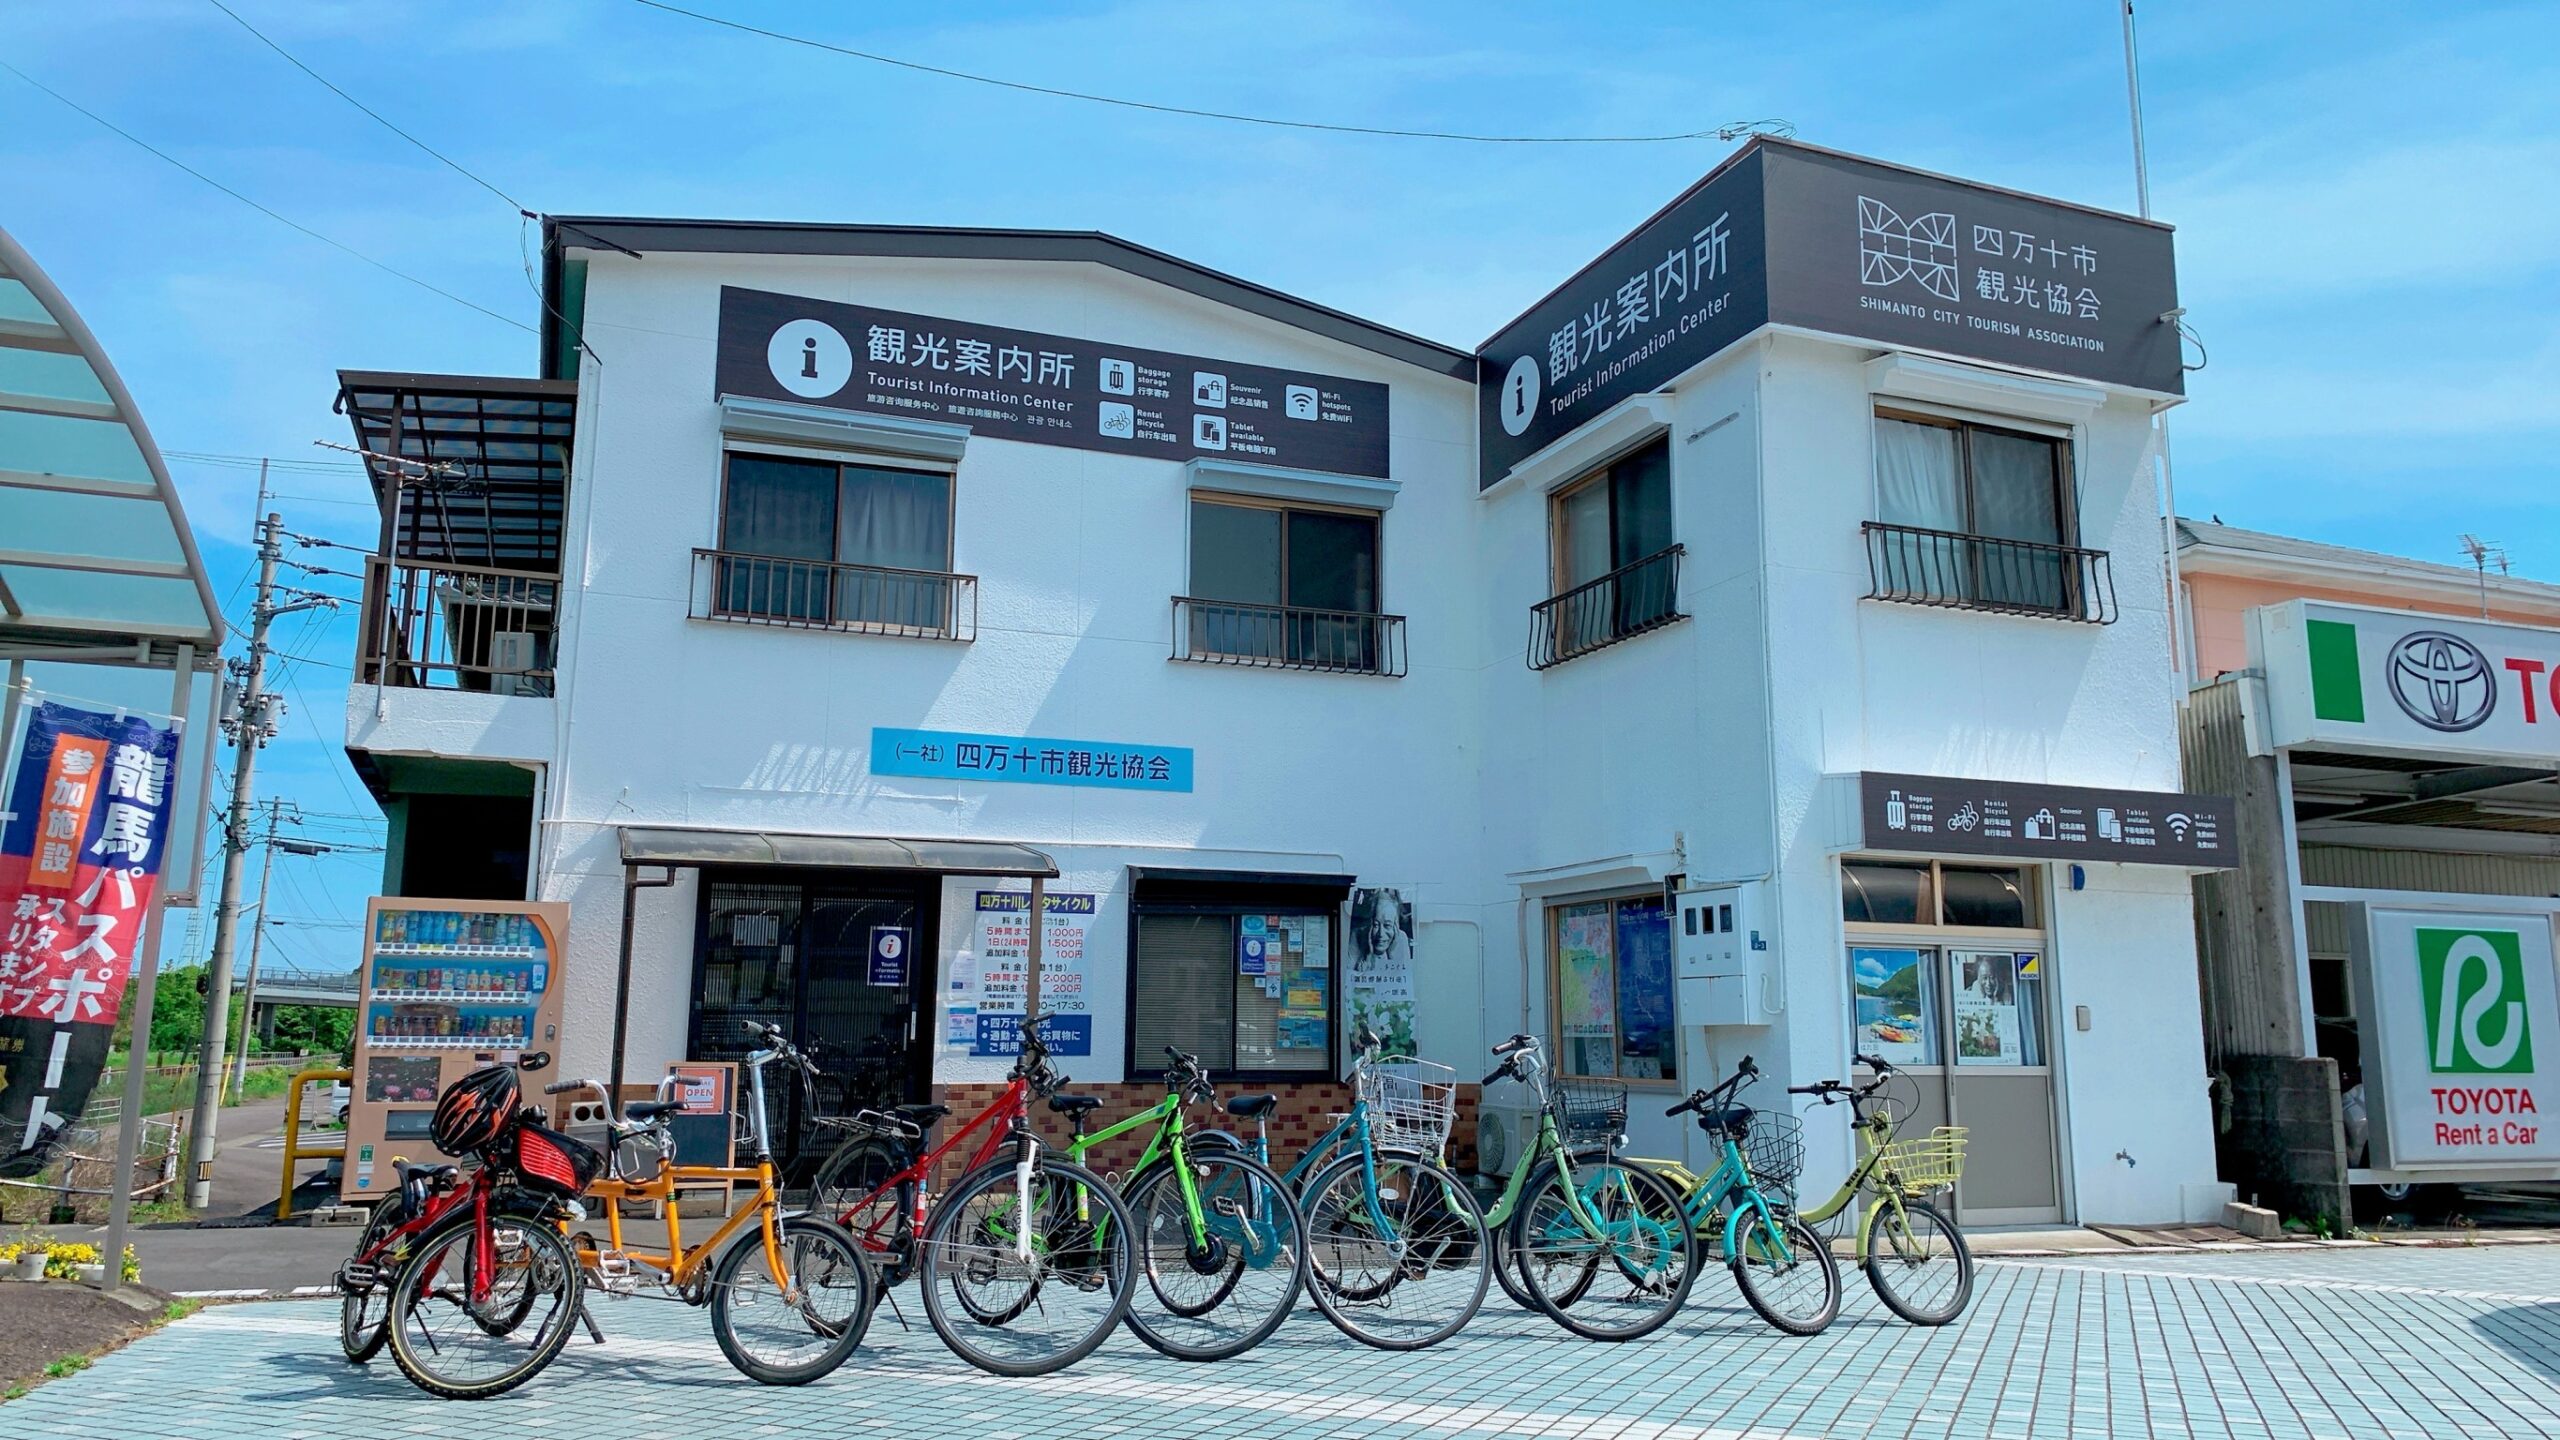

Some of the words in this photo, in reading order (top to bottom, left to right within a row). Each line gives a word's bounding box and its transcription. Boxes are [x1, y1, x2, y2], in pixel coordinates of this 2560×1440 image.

[1973, 225, 2097, 276] 四万十市
[1548, 211, 1731, 387] 観光案内所
[1975, 266, 2101, 321] 観光協会
[1860, 296, 1926, 319] SHIMANTO
[1933, 310, 1960, 325] CITY
[1967, 315, 2020, 336] TOURISM
[2027, 327, 2104, 352] ASSOCIATION
[867, 324, 1075, 389] 観光案内所
[1550, 375, 1593, 416] Tourist
[1596, 329, 1675, 388] Information
[1680, 292, 1731, 334] Center
[1138, 366, 1171, 379] Baggage
[1138, 376, 1168, 387] storage
[867, 372, 924, 392] Tourist
[929, 379, 1018, 405] Information
[1023, 394, 1074, 412] Center
[1137, 387, 1171, 399] 行李寄存
[1230, 383, 1262, 395] Souvenir
[1322, 391, 1341, 401] Wi-Fi
[1322, 400, 1352, 412] hotspots
[1137, 409, 1163, 420] Rental
[1026, 414, 1044, 426] 관광
[1047, 416, 1073, 428] 안내소
[1137, 418, 1165, 430] Bicycle
[1230, 422, 1254, 432] Tablet
[1230, 431, 1265, 443] available
[2504, 657, 2560, 724] T
[895, 742, 944, 763] （一社）
[956, 743, 1171, 781] 四万十市観光協会
[1984, 799, 2008, 808] Rental
[40, 748, 95, 873] 参加施設
[1984, 807, 2009, 816] Bicycle
[980, 895, 1091, 911] 四万十川レタサイクル
[21, 743, 168, 1151] 龍馬パスポート
[988, 938, 1029, 947] 1日(24時間
[10, 897, 66, 1016] スタンプ
[986, 949, 1018, 958] 追加料金
[1055, 950, 1083, 958] 100円
[984, 984, 1017, 993] 追加料金
[1053, 984, 1082, 993] 200円
[979, 1001, 1015, 1010] 営業時間
[990, 1031, 1081, 1041] 通勤・通・お買物に
[686, 1088, 714, 1098] OPEN
[2431, 1088, 2537, 1115] TOYOTA
[2435, 1122, 2482, 1146] Rent
[2488, 1128, 2498, 1144] a
[2504, 1122, 2538, 1145] Car
